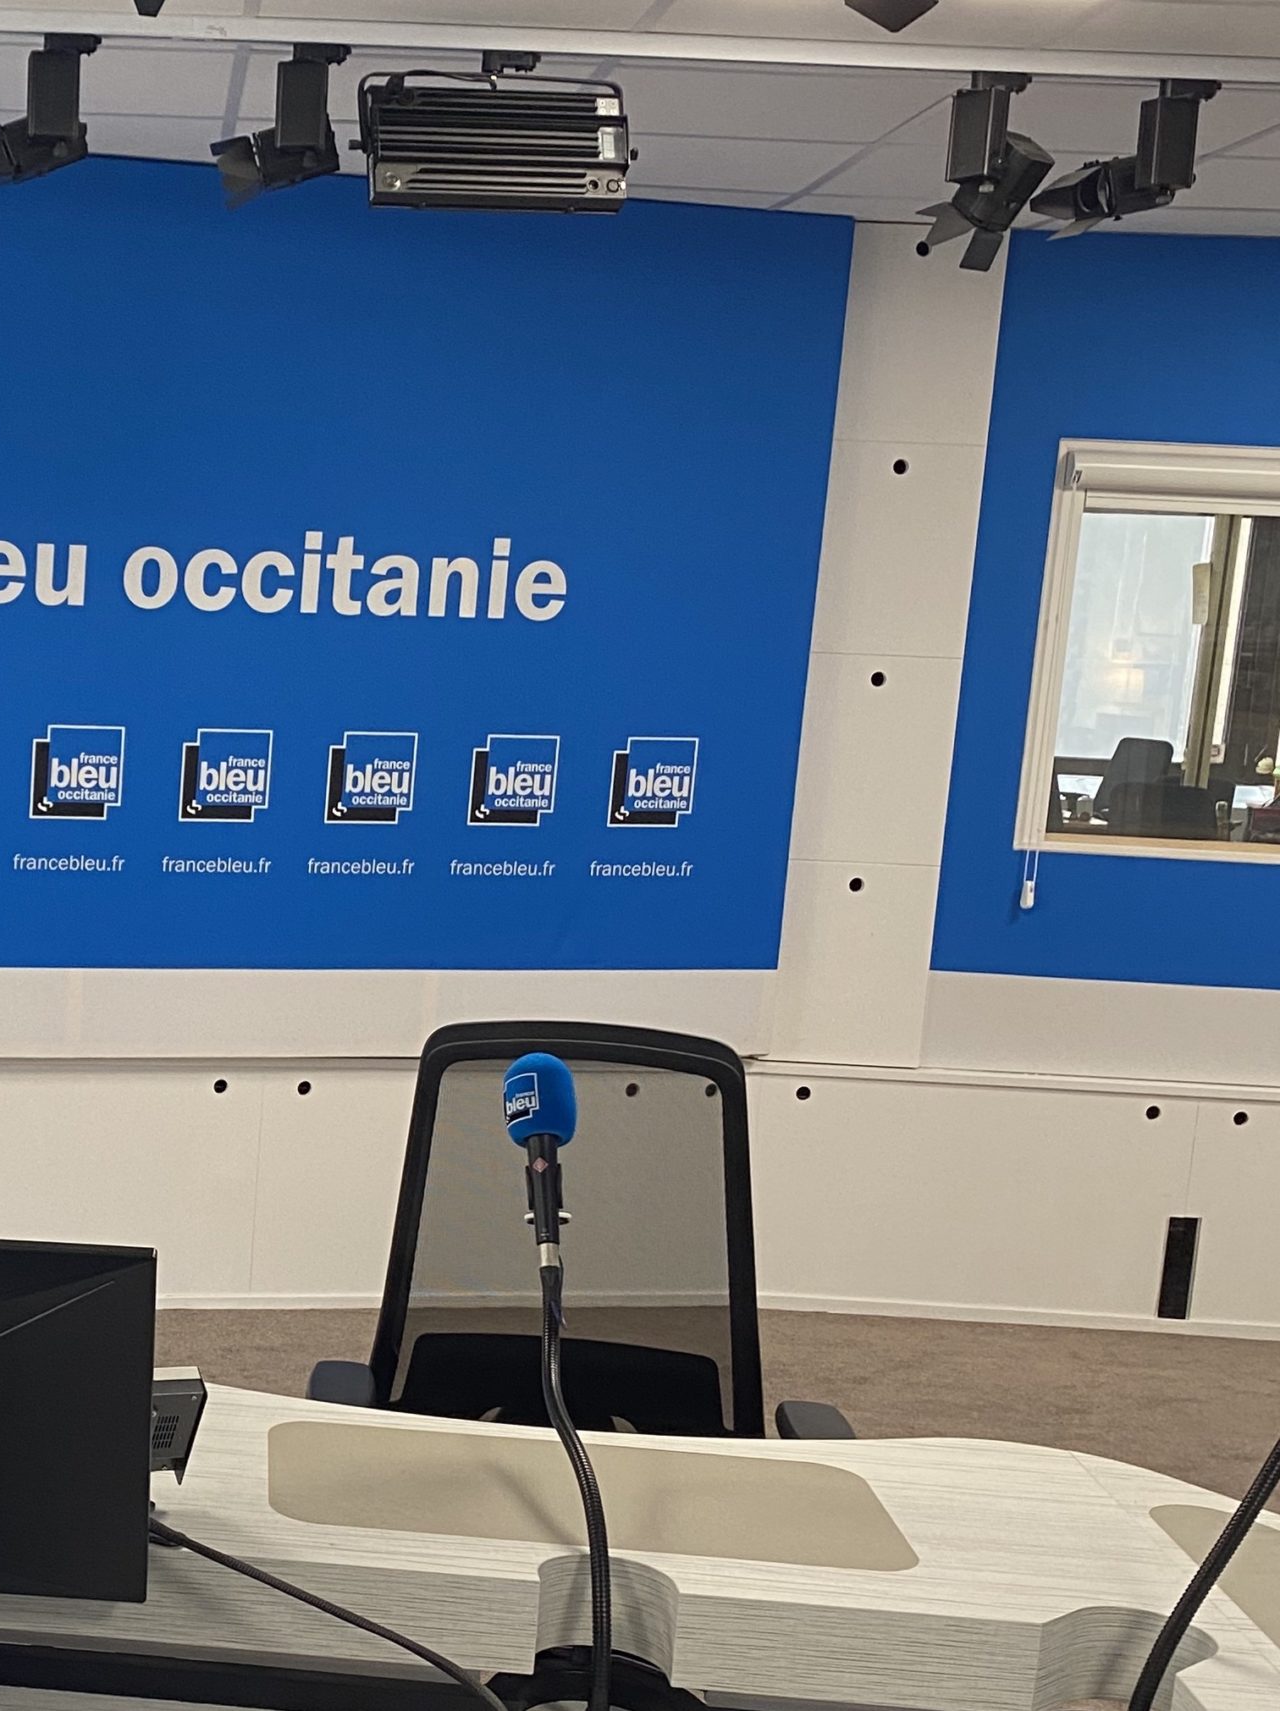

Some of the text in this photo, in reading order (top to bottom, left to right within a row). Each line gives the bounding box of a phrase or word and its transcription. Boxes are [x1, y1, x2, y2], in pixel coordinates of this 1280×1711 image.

[124, 531, 567, 621] occitanie
[80, 752, 118, 764] france
[228, 756, 265, 767] france
[374, 758, 410, 769] france
[516, 760, 552, 772] france
[50, 758, 118, 789] bleu
[200, 761, 265, 791] bleu
[656, 763, 691, 774] france
[345, 764, 409, 794] bleu
[488, 767, 552, 796] bleu
[628, 769, 690, 797] bleu
[57, 788, 115, 800] occitanie
[206, 791, 263, 803] occitanie
[352, 794, 407, 805] occitanie
[494, 796, 548, 808] occitanie
[634, 798, 687, 809] occitanie
[13, 853, 125, 872] francebleu.fr
[162, 855, 272, 874] francebleu.fr
[307, 857, 415, 875] francebleu.fr
[450, 859, 556, 876] francebleu.fr
[590, 860, 694, 877] francebleu.fr
[506, 1095, 536, 1115] bleu
